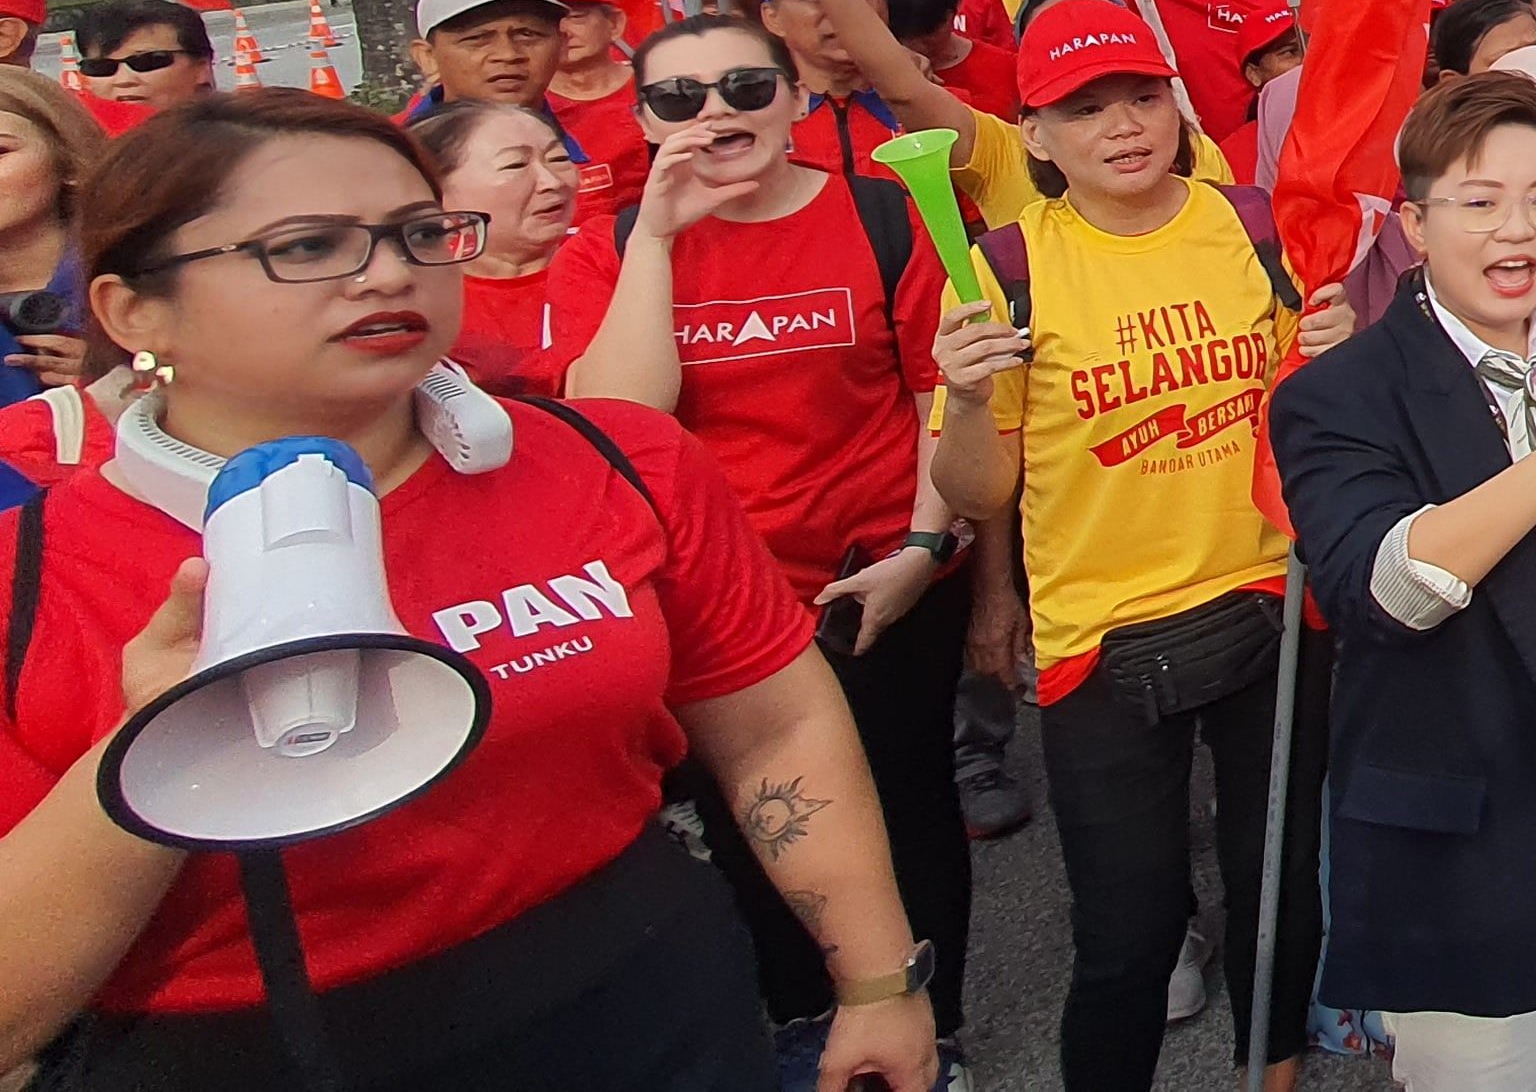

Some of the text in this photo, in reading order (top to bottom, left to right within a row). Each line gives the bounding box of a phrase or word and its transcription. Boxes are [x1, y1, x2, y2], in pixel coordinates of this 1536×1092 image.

[1049, 33, 1137, 61] HARAPAN
[1113, 300, 1217, 356] #KITA
[1122, 419, 1160, 457] AYUH
[1141, 440, 1241, 475] BANDAR UTAMA
[490, 636, 593, 680] TUNKU
